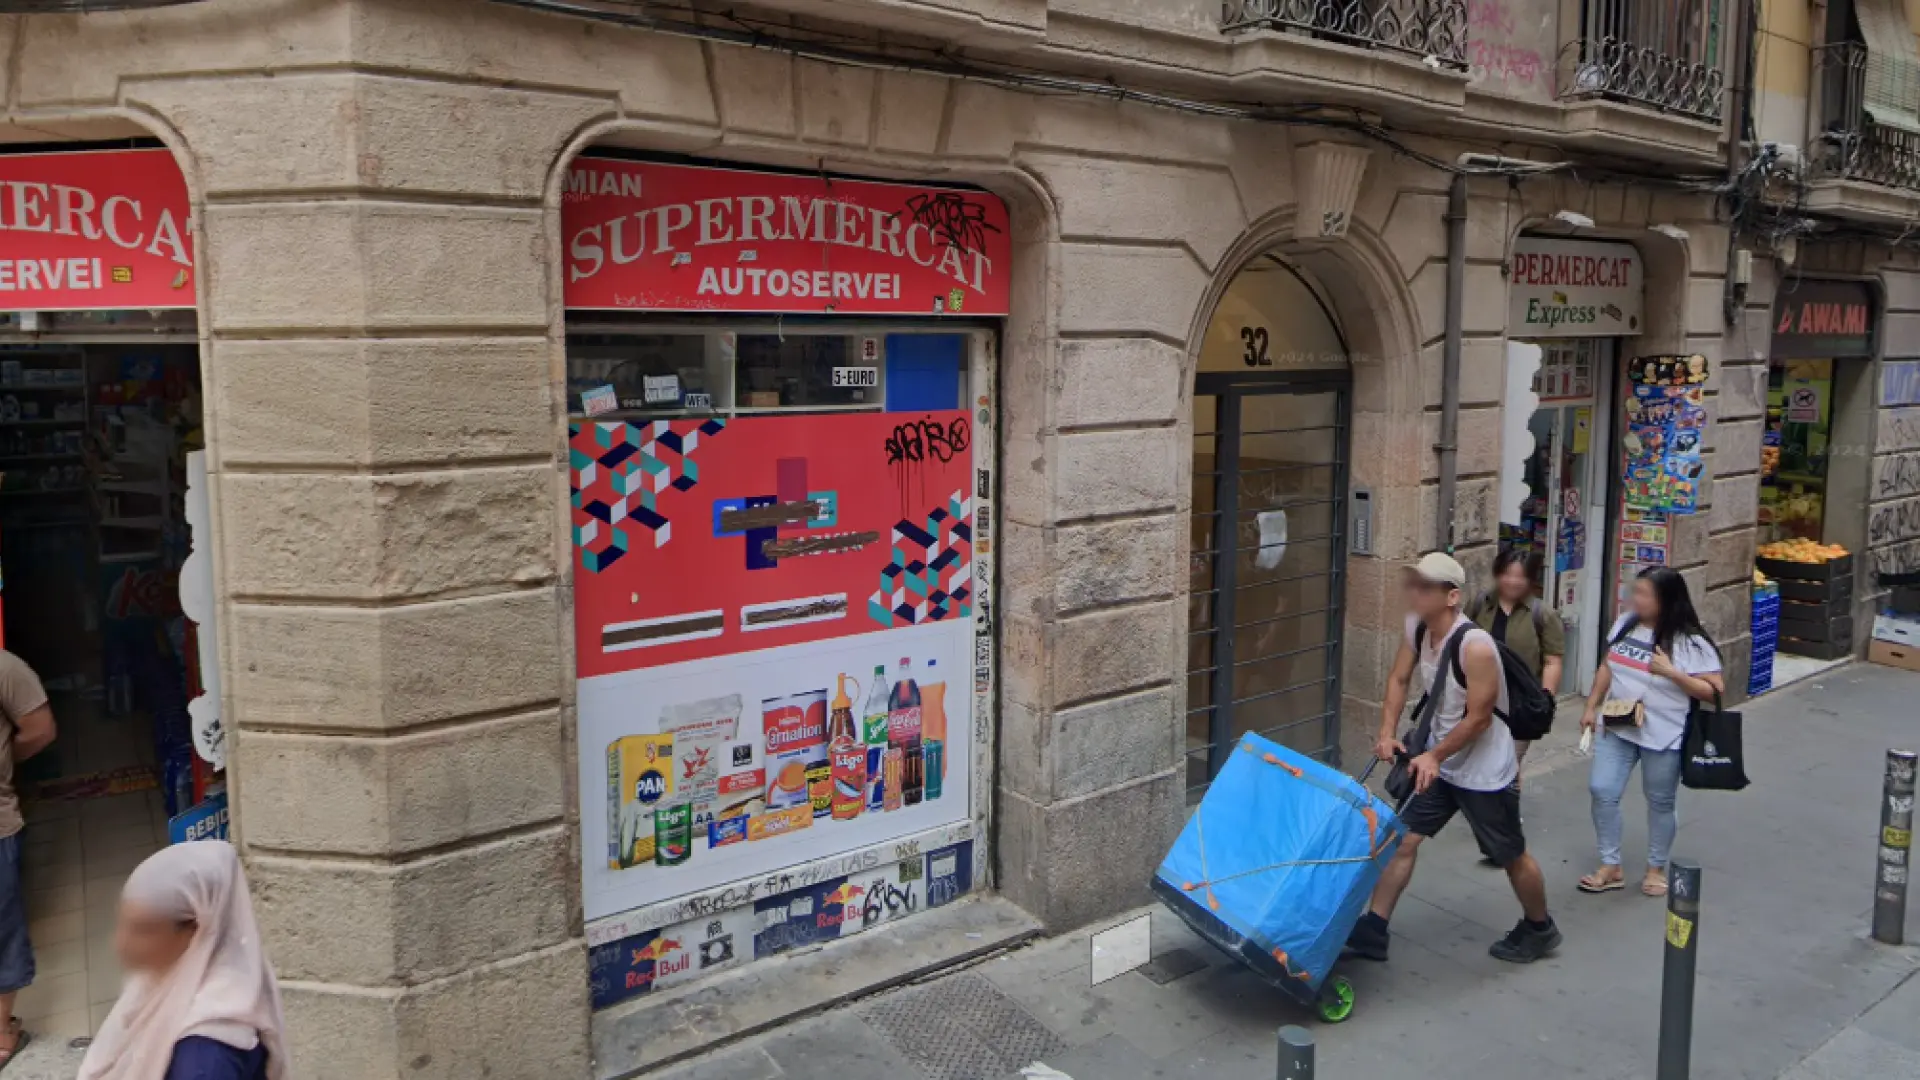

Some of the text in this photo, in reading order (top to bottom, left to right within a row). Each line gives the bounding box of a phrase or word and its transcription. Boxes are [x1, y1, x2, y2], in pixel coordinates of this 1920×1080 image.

[563, 169, 642, 198] MIAN
[0, 180, 194, 267] ERCA
[569, 195, 992, 296] SUPERMERCAT
[696, 266, 900, 300] AUTOSERVEI
[1513, 253, 1632, 288] PERMERCAT
[1525, 297, 1596, 329] Express
[1798, 302, 1867, 335] AWAMI
[1240, 326, 1272, 367] 32
[834, 369, 876, 386] 5-EURO
[835, 754, 864, 772] Ligo
[635, 776, 665, 801] PAN
[816, 905, 845, 929] Red
[625, 951, 690, 989] Red Bull
